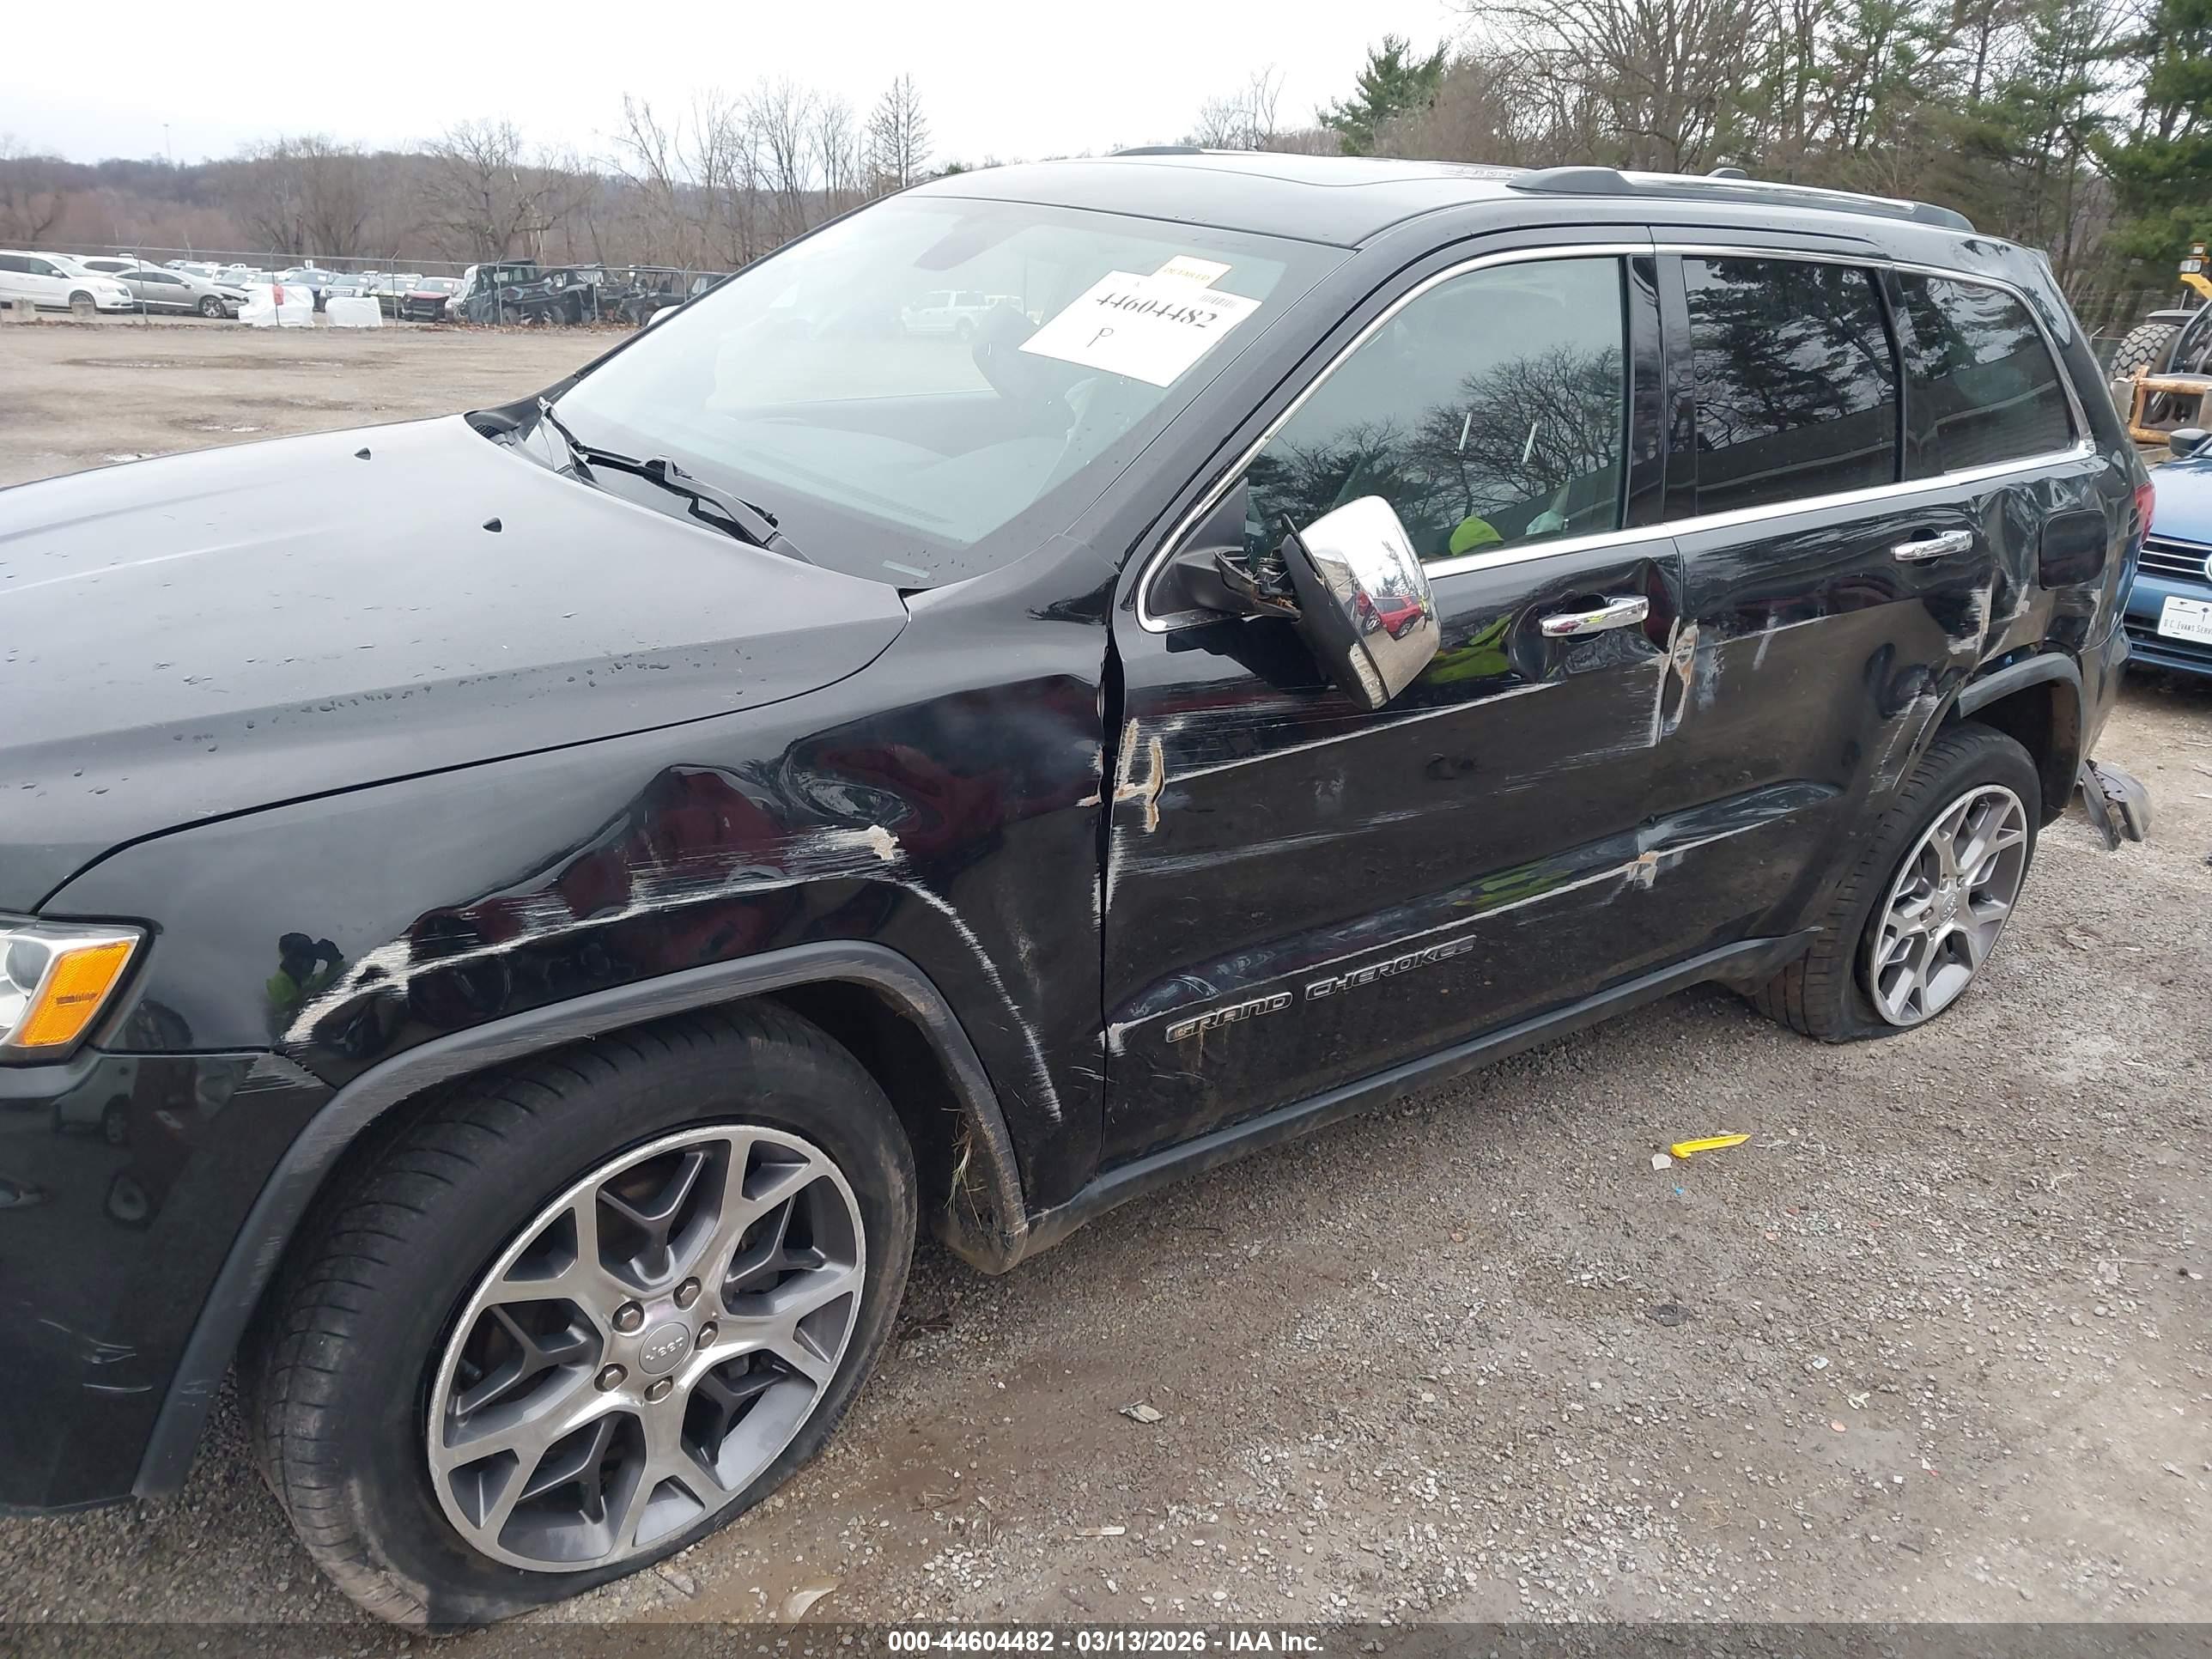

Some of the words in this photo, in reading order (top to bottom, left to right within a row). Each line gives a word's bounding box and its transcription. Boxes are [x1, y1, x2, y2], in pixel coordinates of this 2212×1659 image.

[1096, 292, 1218, 328] 44604482
[1086, 327, 1115, 348] P
[1165, 991, 1293, 1043] GRAND
[1304, 934, 1478, 1001] CHEROKEE
